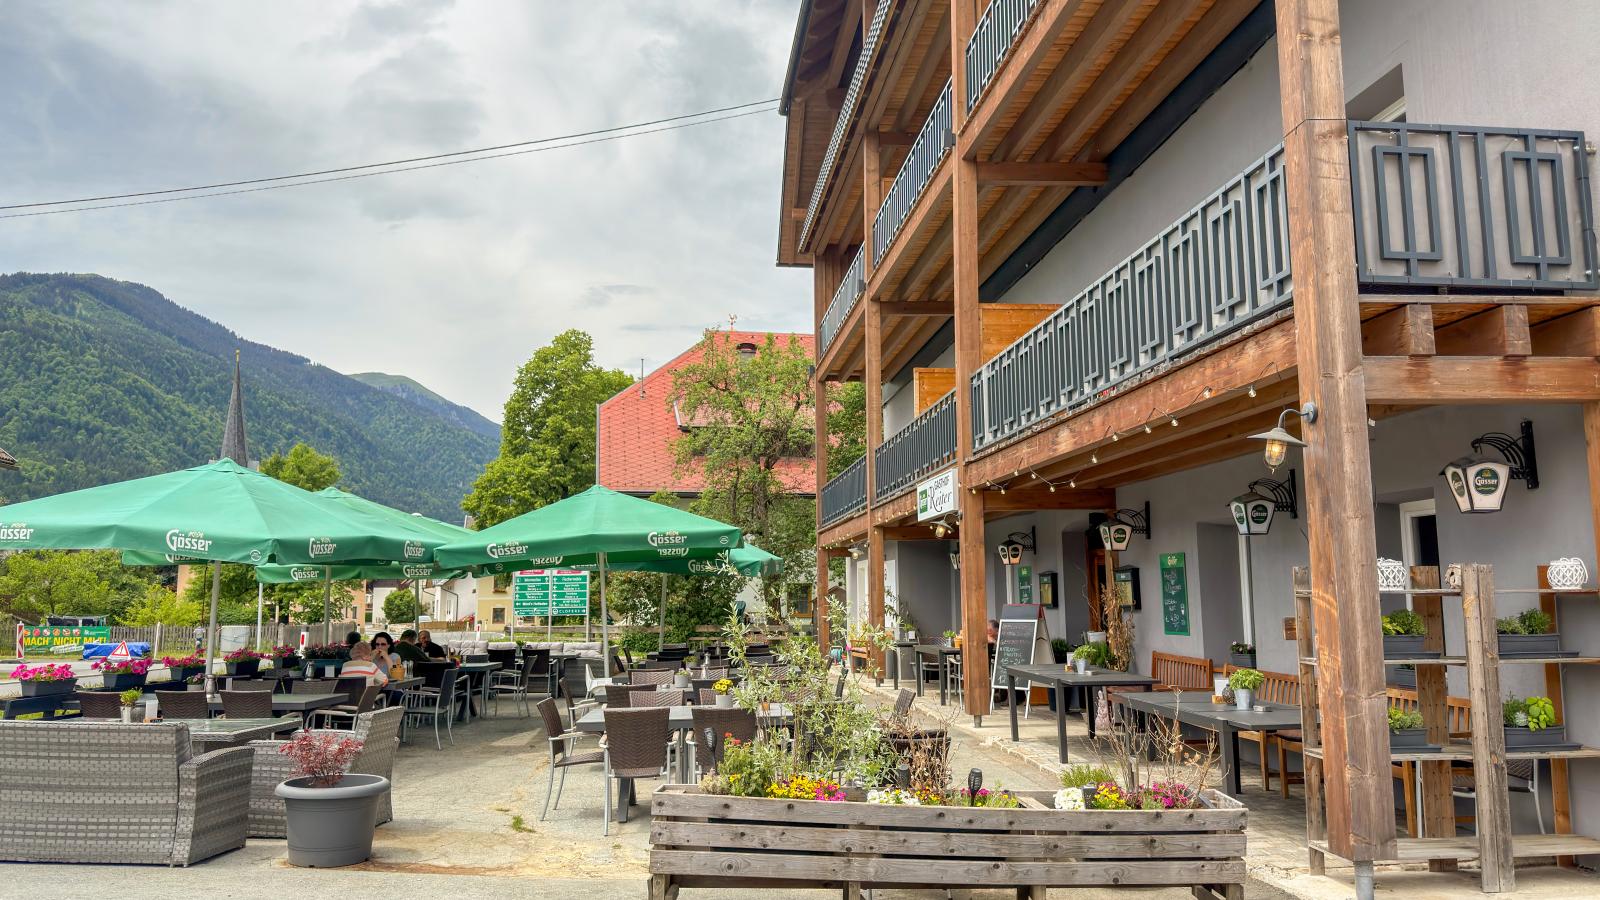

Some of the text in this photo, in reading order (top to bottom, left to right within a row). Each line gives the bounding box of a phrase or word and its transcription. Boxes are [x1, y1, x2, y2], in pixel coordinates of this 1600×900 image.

[1475, 476, 1498, 486] Gösser
[928, 486, 952, 513] Reiter
[0, 522, 34, 540] össer
[166, 529, 212, 552] Gösser
[648, 532, 687, 547] Gösser
[309, 537, 337, 559] Gösser
[404, 540, 425, 558] Gösser
[486, 543, 529, 559] Gösser
[291, 567, 319, 581] Gösser
[403, 565, 432, 578] Gösser
[53, 636, 82, 646] NICHT
